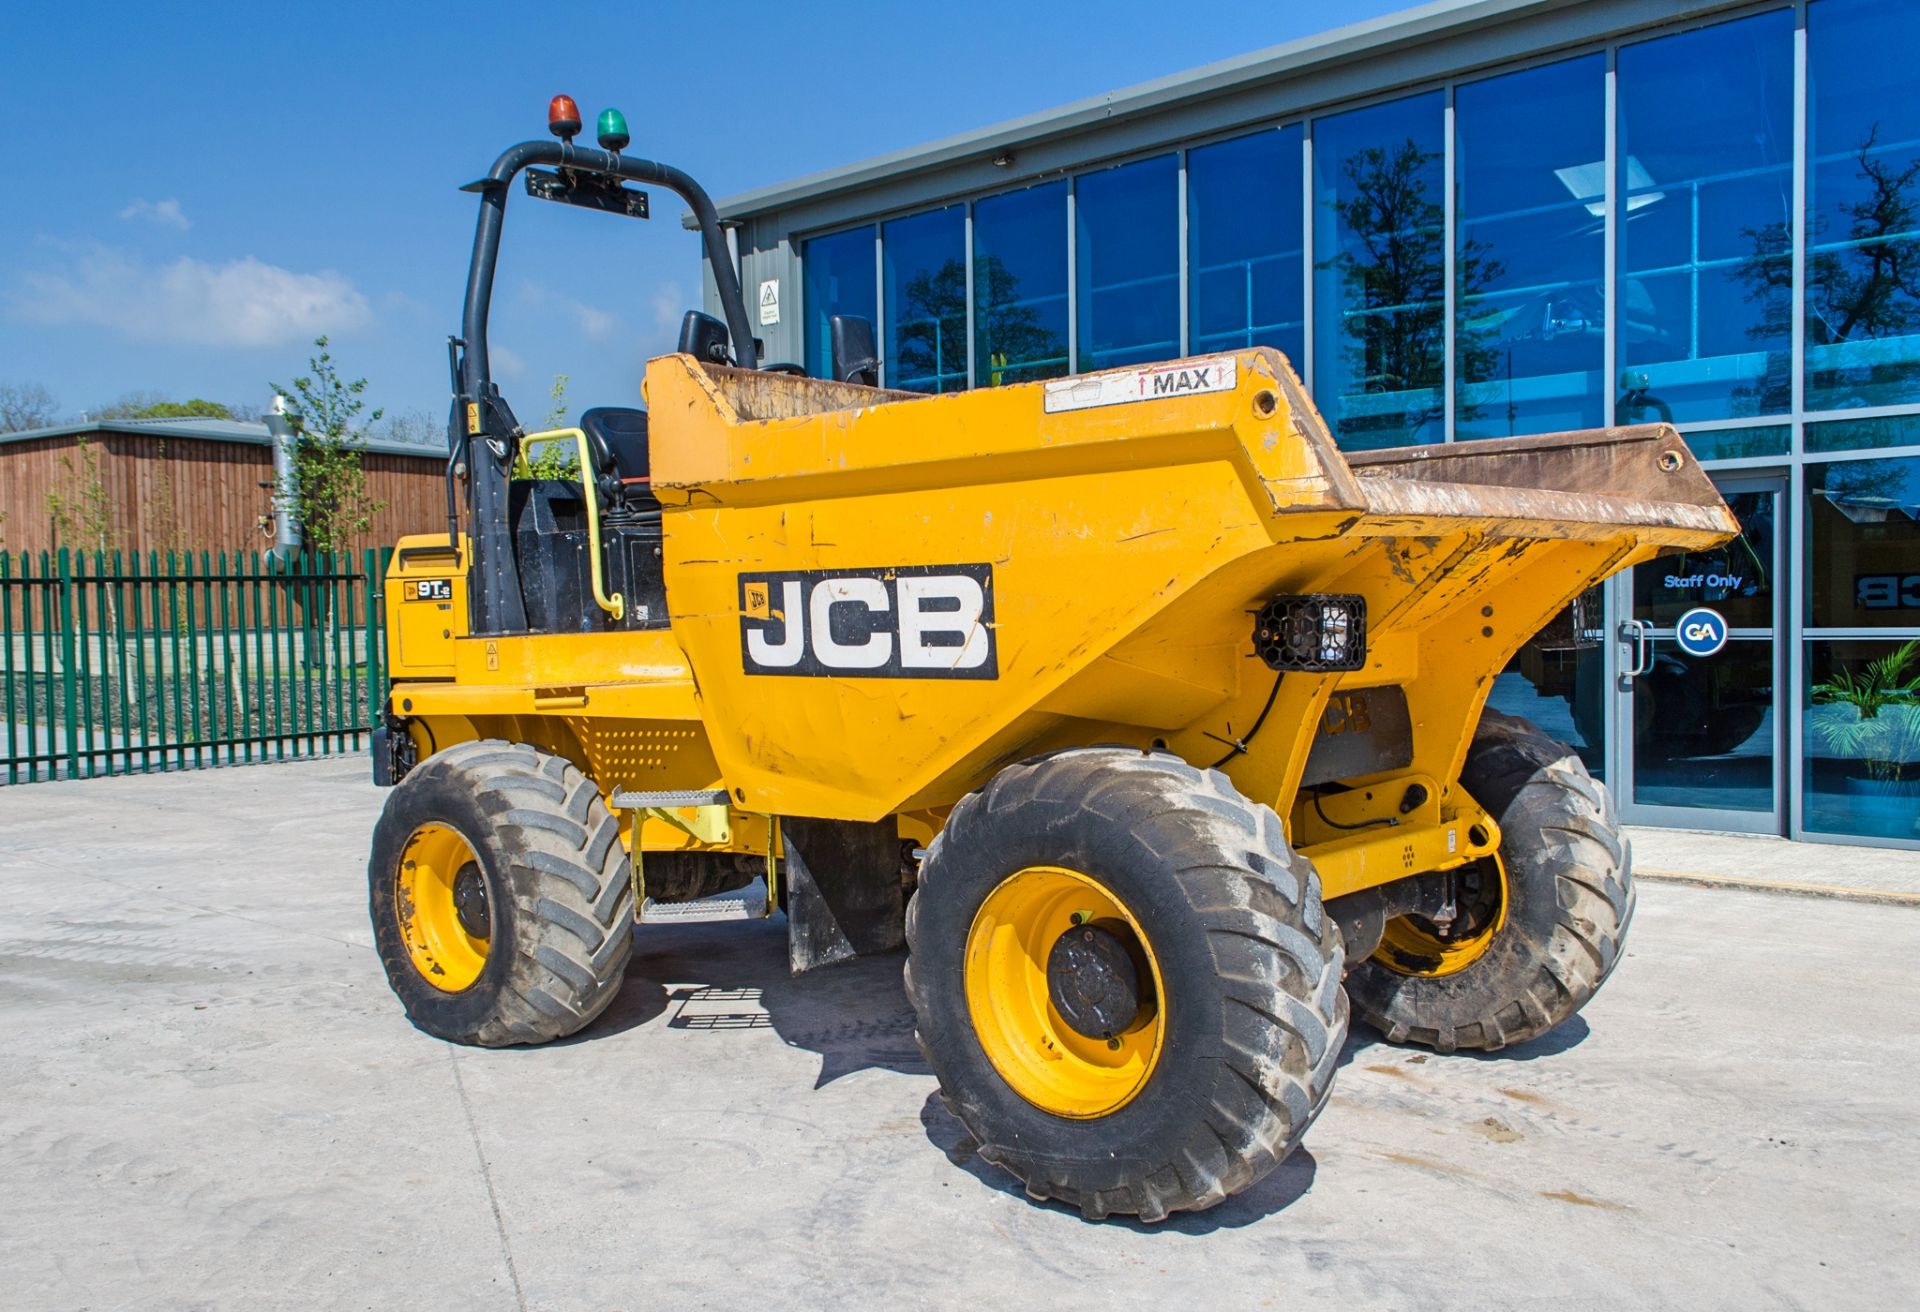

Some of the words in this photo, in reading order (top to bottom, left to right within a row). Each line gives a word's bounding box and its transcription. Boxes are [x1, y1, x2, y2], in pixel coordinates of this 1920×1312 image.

[1153, 368, 1210, 395] MAX
[1664, 575, 1704, 588] Staff
[1706, 574, 1742, 590] Only
[751, 592, 765, 608] JCB
[747, 575, 989, 668] JCB
[1318, 696, 1370, 736] CB
